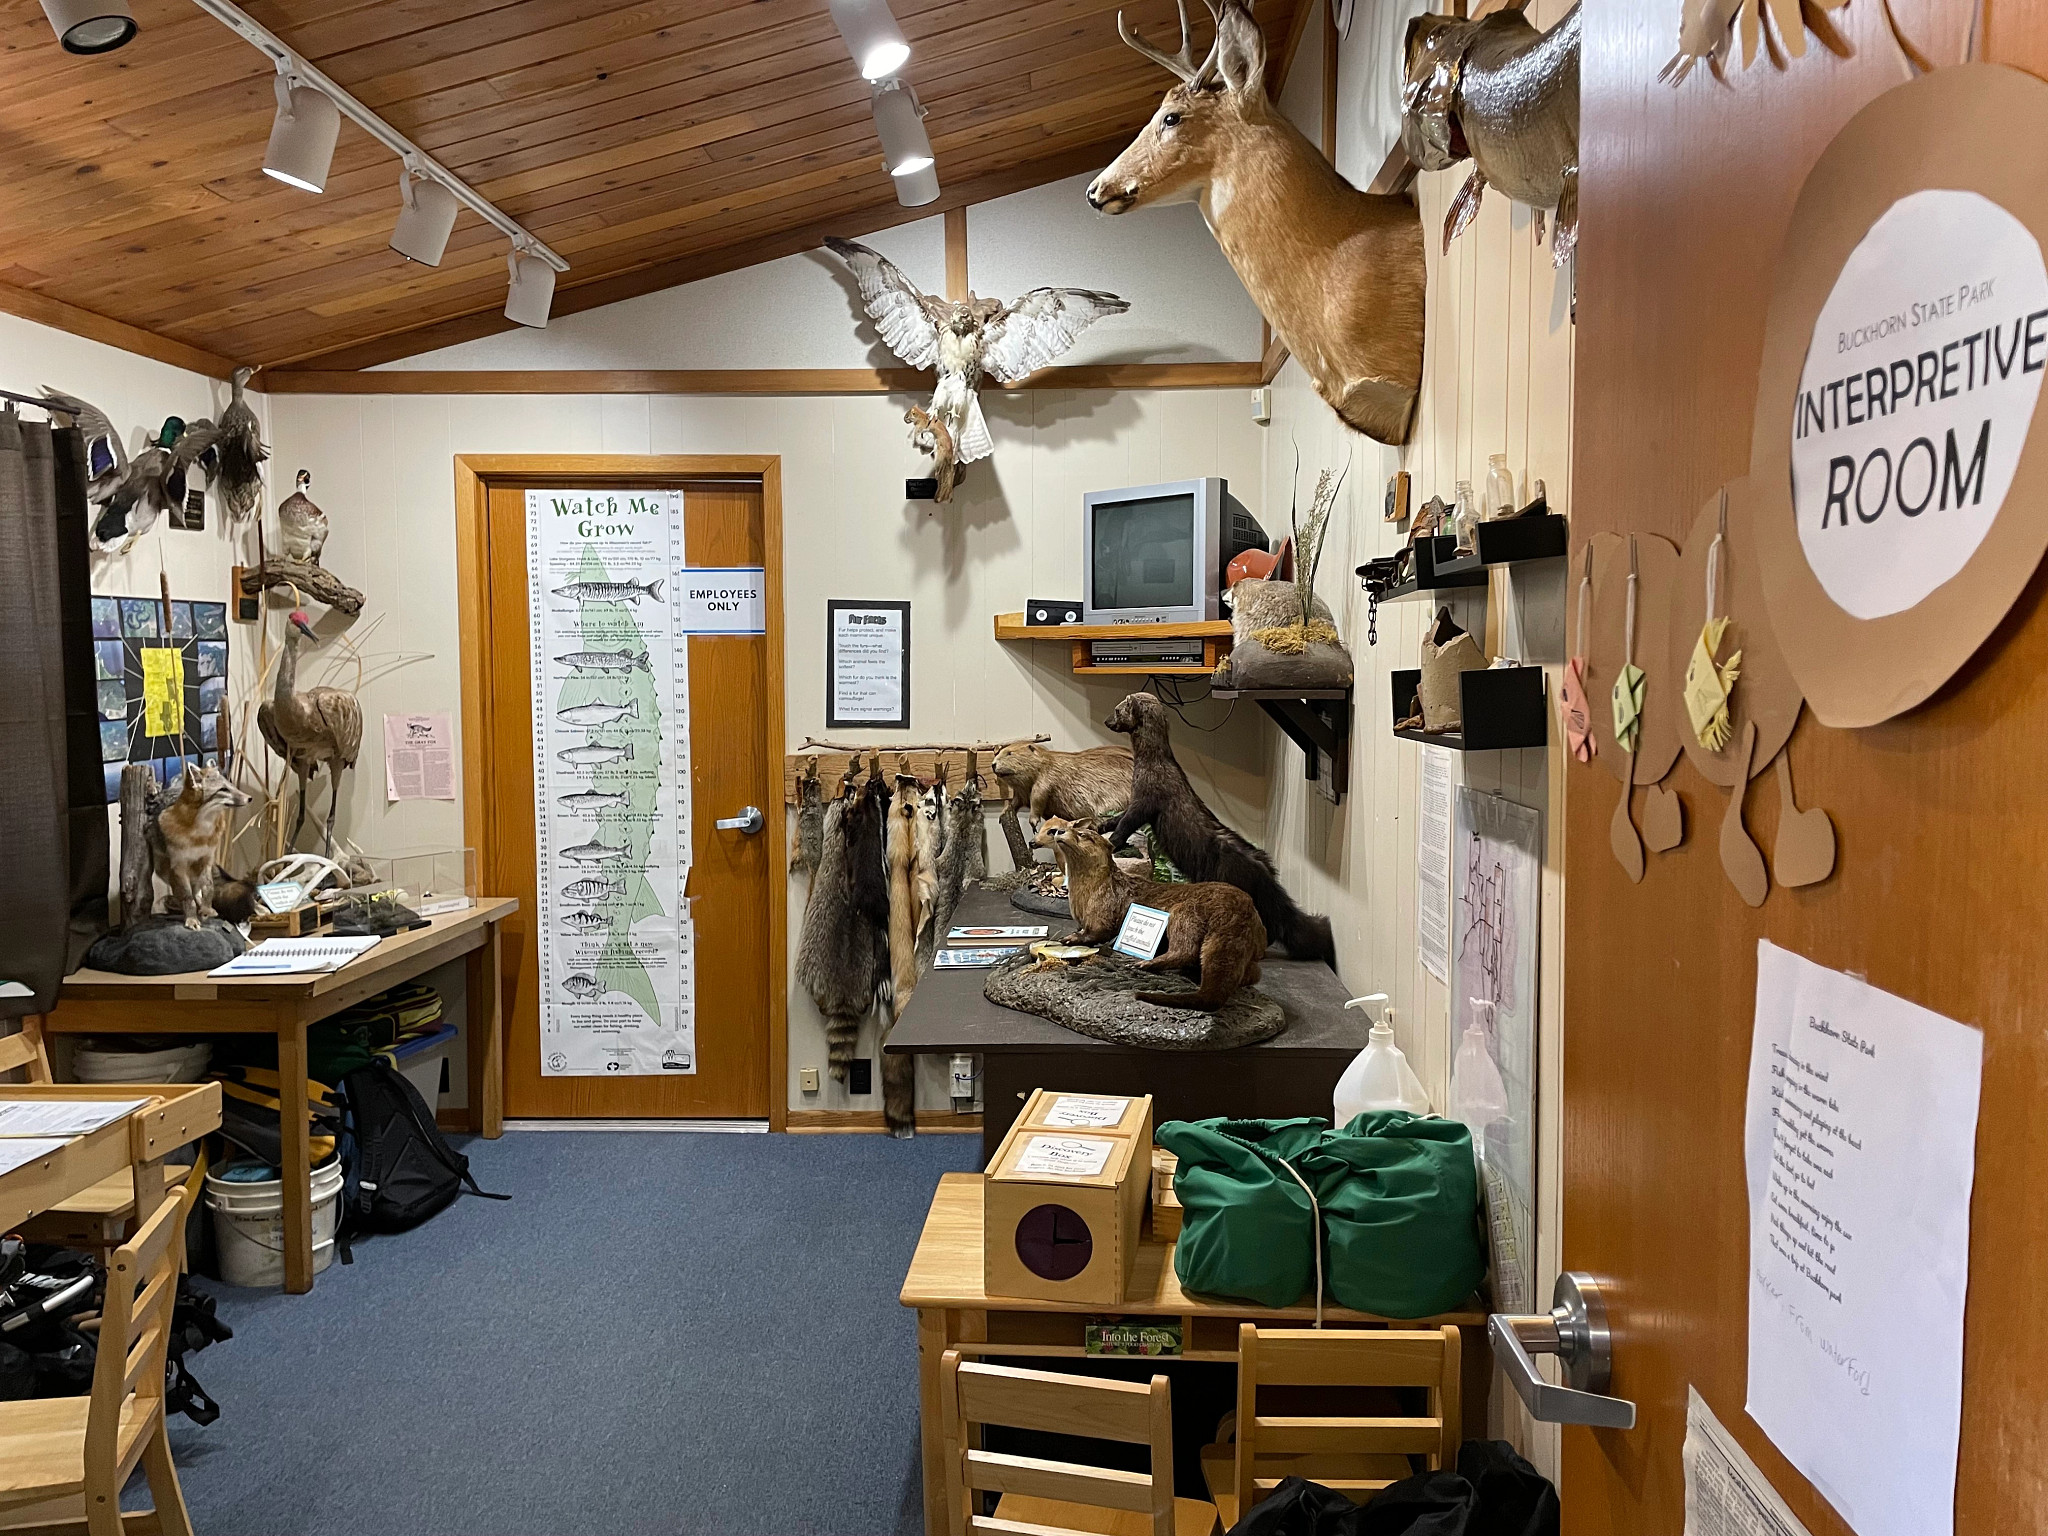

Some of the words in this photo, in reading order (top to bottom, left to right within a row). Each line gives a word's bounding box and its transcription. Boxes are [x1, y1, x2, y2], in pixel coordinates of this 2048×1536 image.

[1838, 311, 1907, 354] BUCKHORN
[1912, 295, 1954, 328] STATE
[1958, 277, 1998, 310] PARK
[1796, 308, 2048, 440] INTERPRETIVE
[1821, 419, 1992, 529] ROOM
[550, 496, 618, 517] Watch
[628, 497, 659, 516] Me
[578, 520, 634, 538] Grow
[689, 589, 757, 599] EMPLOYEES
[708, 601, 740, 611] ONLY
[1809, 1016, 1841, 1040] Buckhorn
[1041, 1144, 1093, 1156] Discovery
[1102, 1332, 1120, 1342] Into
[1123, 1332, 1138, 1342] the
[1140, 1332, 1169, 1342] Forest
